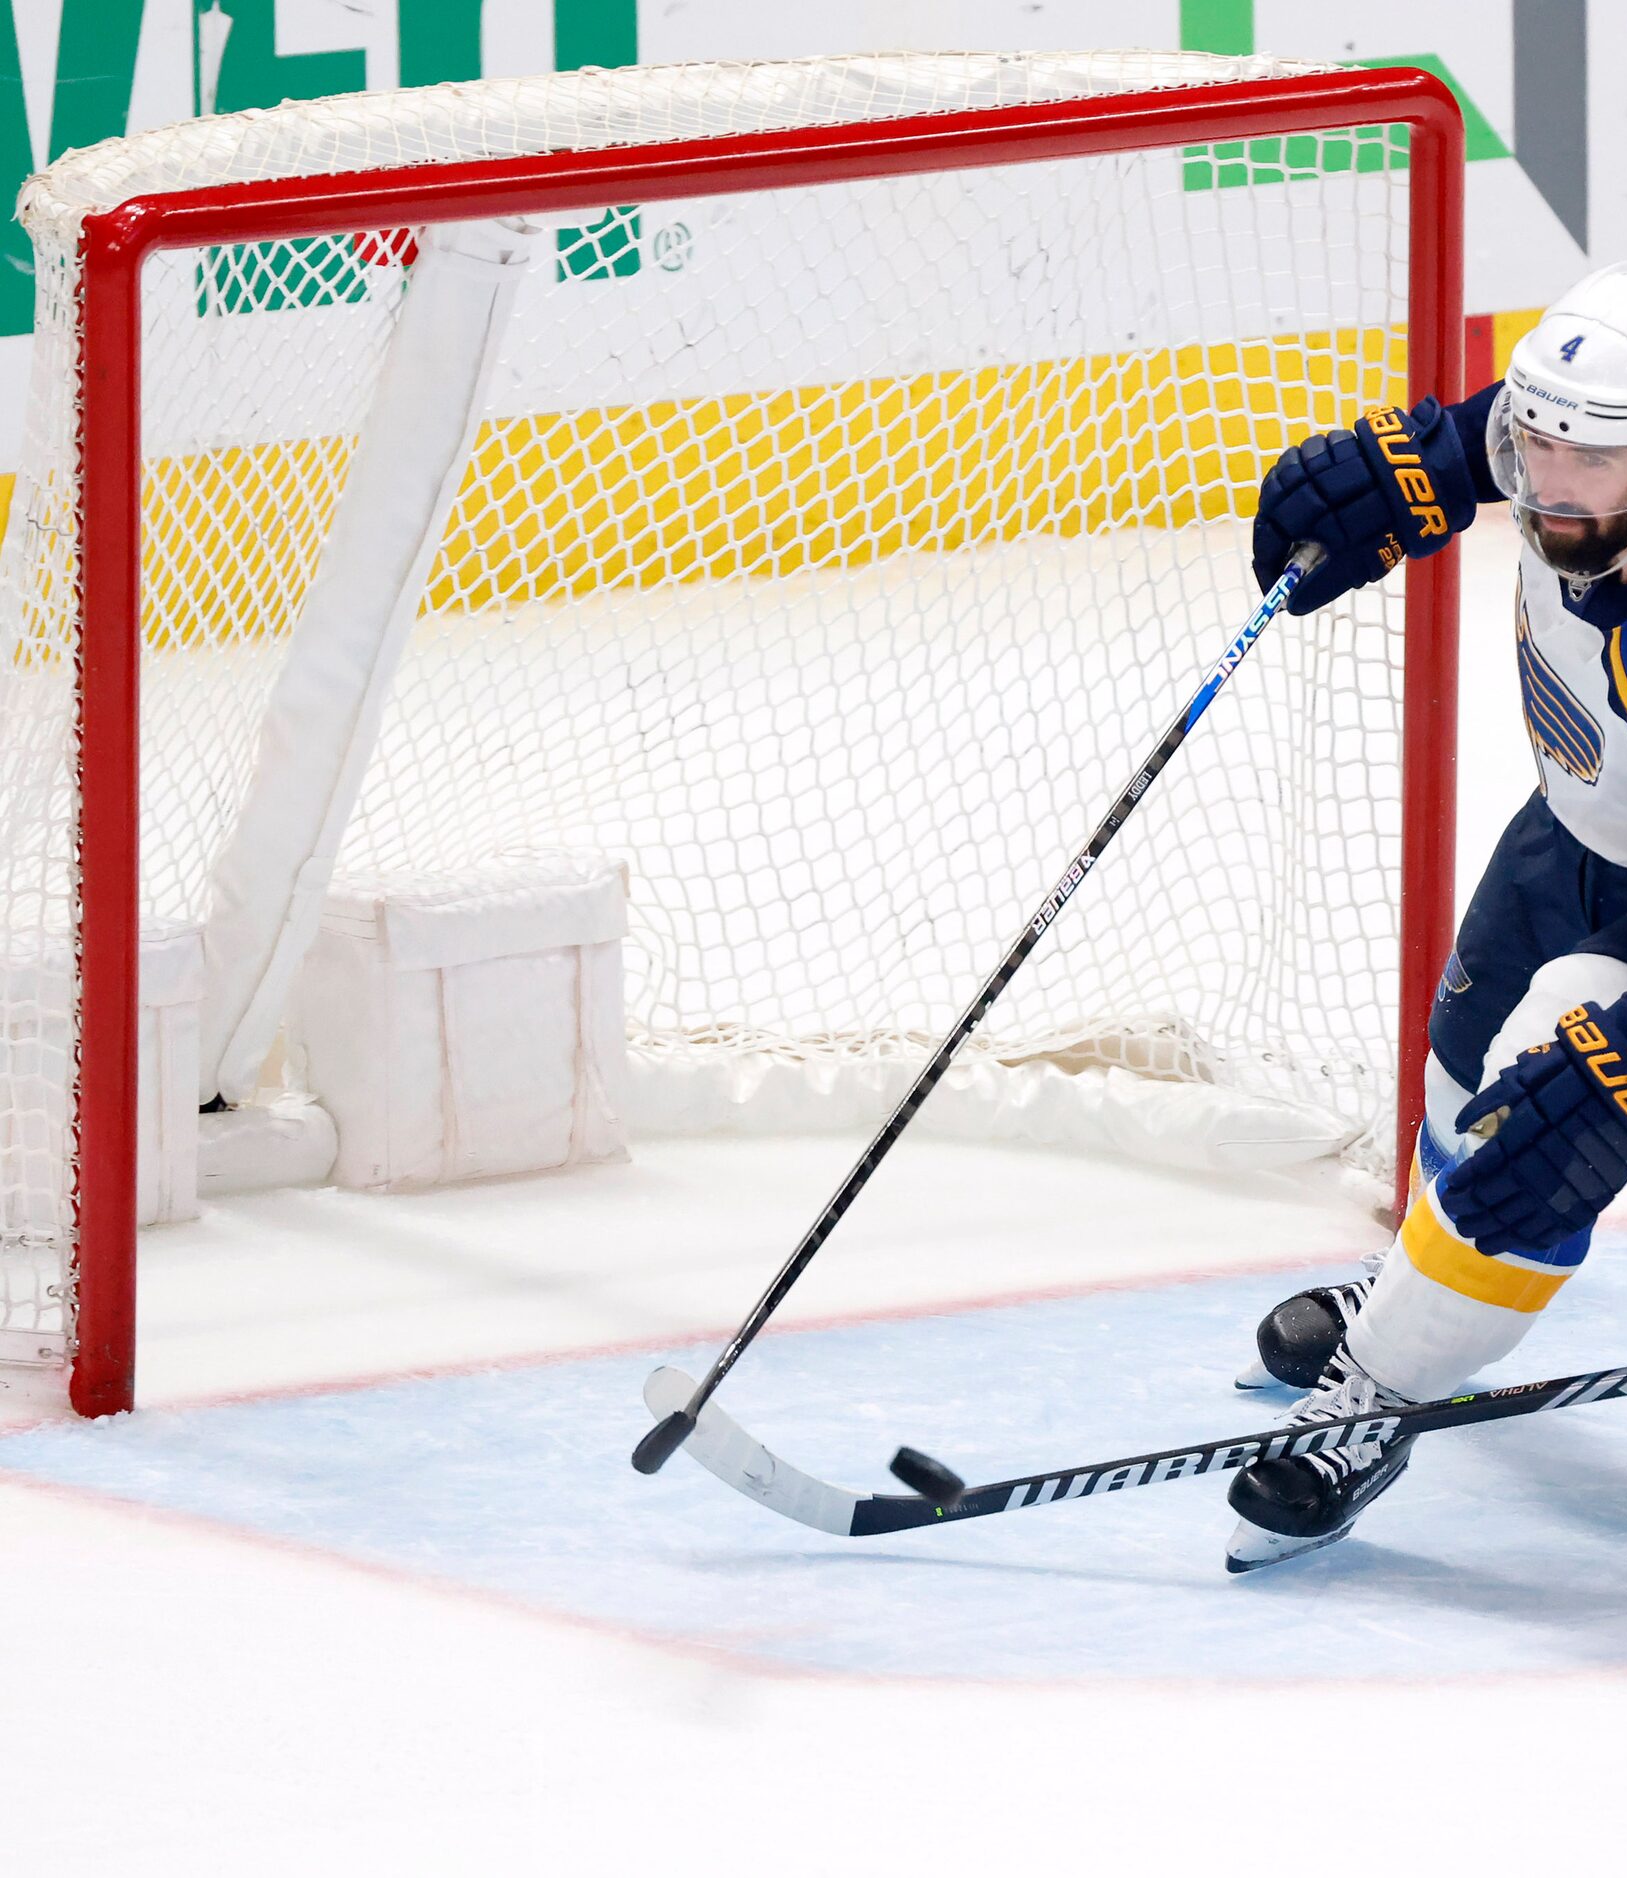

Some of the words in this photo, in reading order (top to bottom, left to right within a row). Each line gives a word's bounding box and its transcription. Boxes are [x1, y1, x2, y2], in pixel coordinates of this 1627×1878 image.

[1559, 334, 1586, 363] 4
[1206, 609, 1271, 692] SYNC
[1126, 771, 1152, 802] LEDDY
[1489, 1380, 1550, 1398] ALPHA
[1004, 1415, 1402, 1513] WARRIOR
